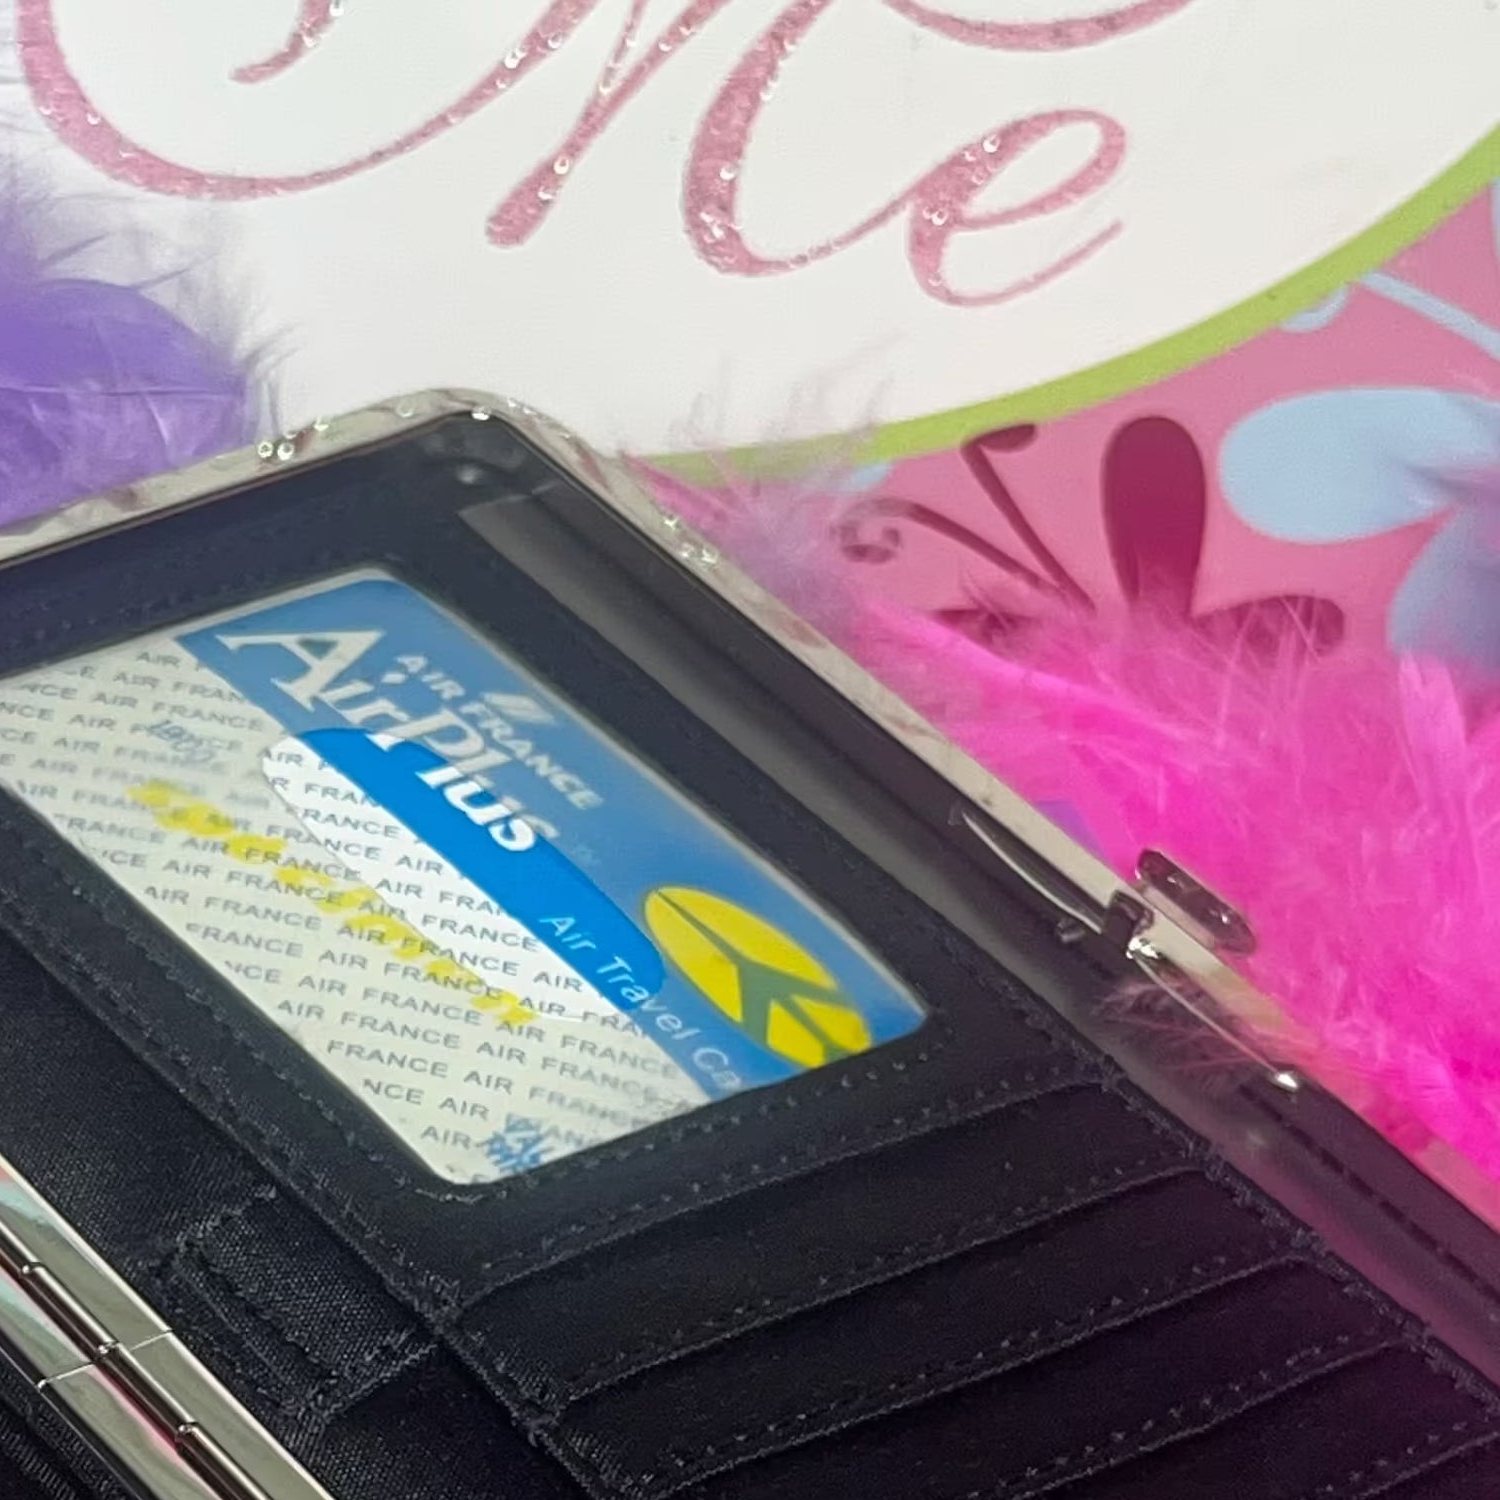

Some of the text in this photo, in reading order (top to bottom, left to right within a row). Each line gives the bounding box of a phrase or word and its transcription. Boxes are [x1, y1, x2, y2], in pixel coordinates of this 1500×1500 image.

[113, 672, 161, 689] AIR
[136, 651, 181, 669] AIR
[69, 714, 117, 731] AIR
[90, 692, 139, 709] AIR
[153, 701, 265, 731] FRANCE
[397, 655, 603, 810] AIR FRANCE
[53, 737, 101, 753] AIR
[181, 837, 230, 856] AIR
[245, 849, 361, 881] FRANCE
[375, 877, 423, 899] AIR
[266, 824, 381, 861] FRANCE
[395, 855, 443, 876] AIR
[163, 859, 211, 879] AIR
[227, 871, 345, 906] FRANCE
[358, 901, 406, 923] AIR
[421, 915, 541, 952] FRANCE
[145, 886, 583, 993] AIR FRANCE AIR FRANCE AIR
[318, 949, 368, 970] AIR
[384, 962, 505, 999] FRANCE
[519, 997, 566, 1017] AIR
[539, 917, 596, 950] Air
[596, 955, 701, 1040] Travel
[277, 1000, 325, 1020] AIR
[341, 1012, 461, 1049] FRANCE
[476, 1041, 527, 1064] AIR
[540, 1057, 659, 1104] FRANCE
[298, 975, 347, 996] AIR
[363, 987, 484, 1026] FRANCE
[495, 1022, 545, 1043] AIR
[560, 1035, 680, 1080] FRANCE
[328, 1039, 449, 1078] FRANCE
[463, 1070, 514, 1094] AIR
[439, 1097, 490, 1121] AIR
[420, 1126, 472, 1150] AIR
